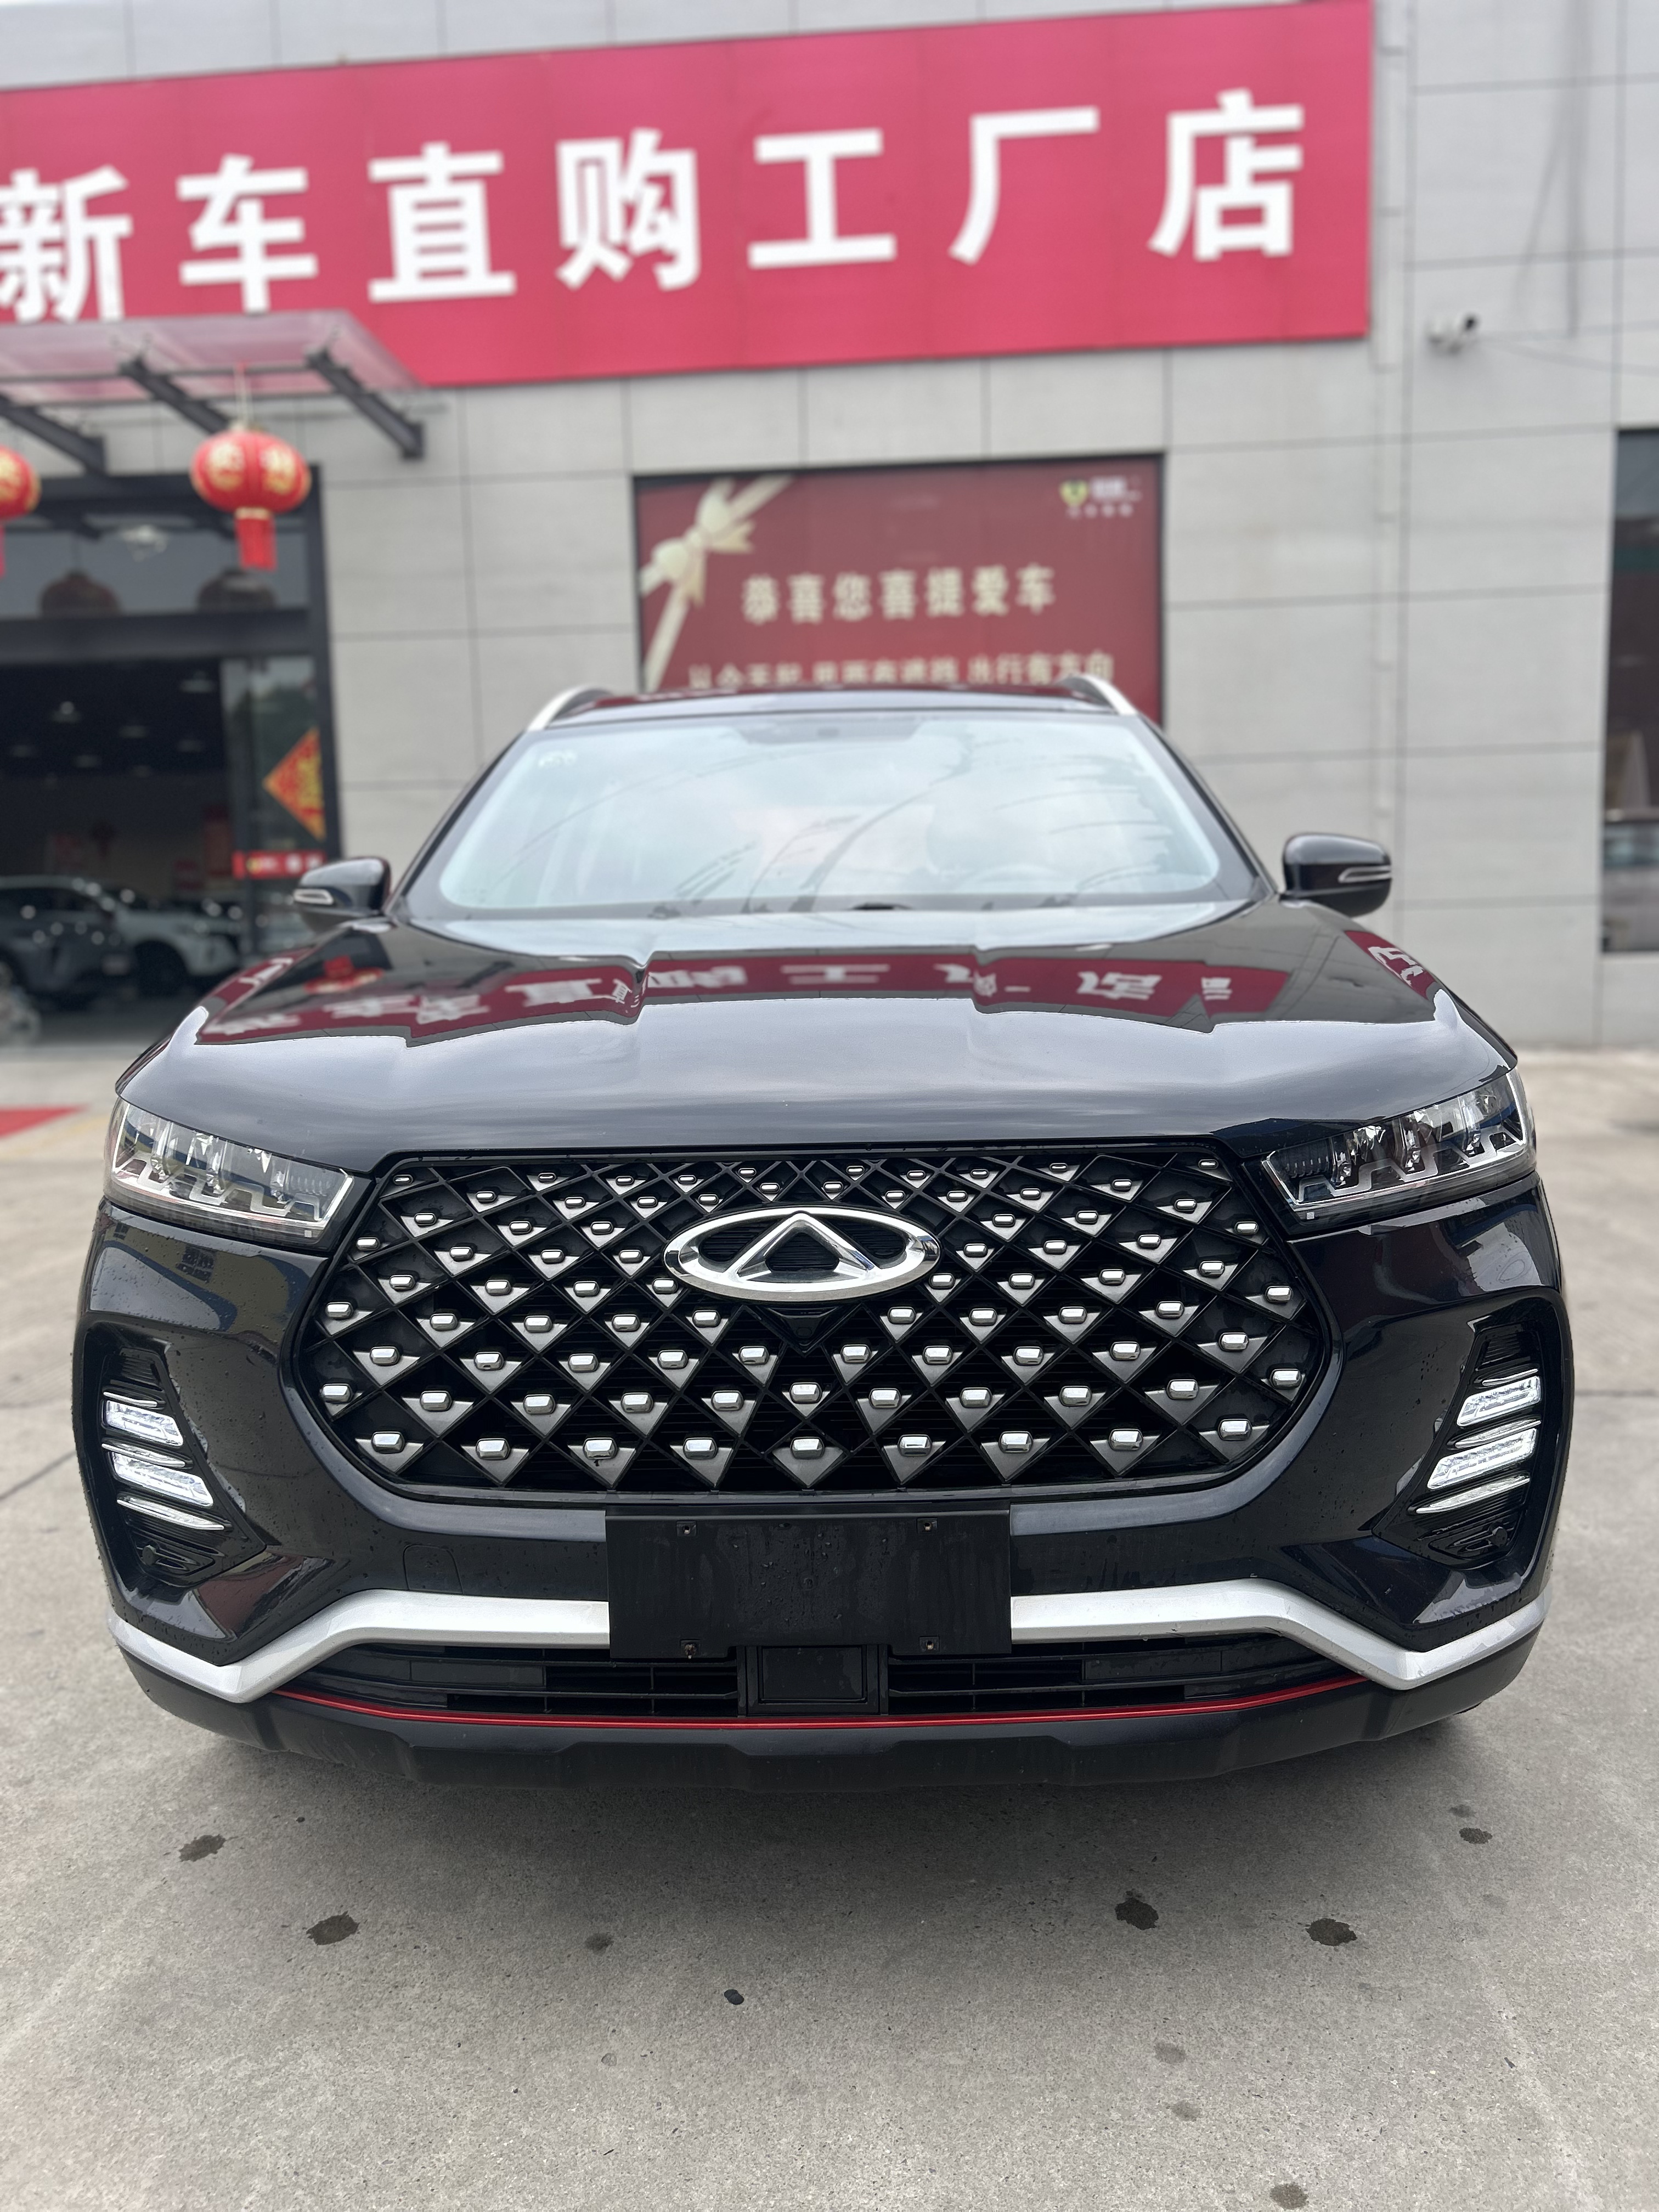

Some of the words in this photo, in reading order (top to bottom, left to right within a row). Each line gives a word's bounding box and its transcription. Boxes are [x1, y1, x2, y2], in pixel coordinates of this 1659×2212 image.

[0, 89, 1304, 323] 新车直购工厂店
[742, 563, 1054, 624] 恭喜您喜提爱车
